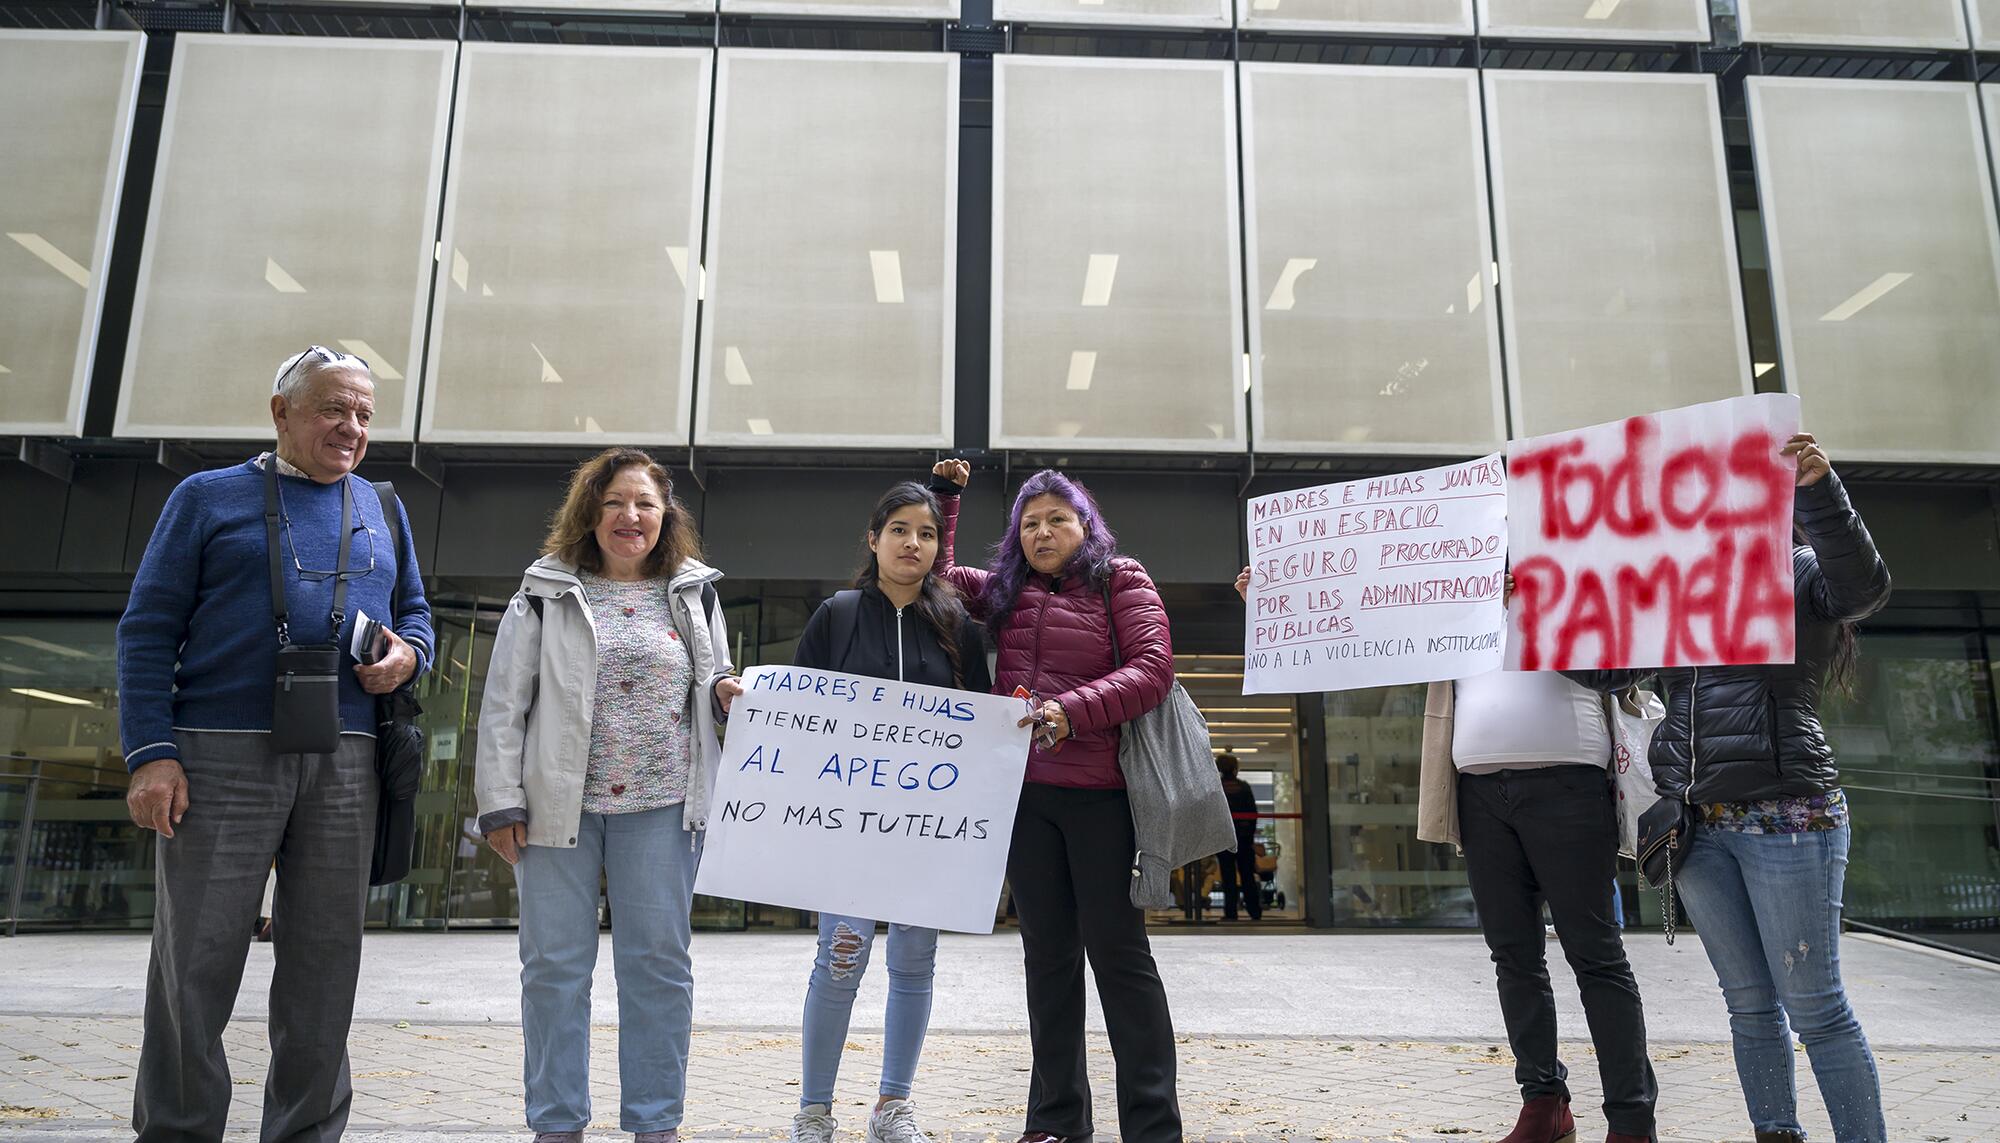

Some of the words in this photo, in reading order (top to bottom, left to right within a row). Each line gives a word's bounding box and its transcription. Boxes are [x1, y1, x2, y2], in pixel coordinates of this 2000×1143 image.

[1254, 489, 1328, 521] MADRES
[1342, 485, 1355, 504] E
[1366, 476, 1425, 500] HIJAS
[1439, 459, 1503, 491] JUNTAS
[1255, 525, 1283, 548] EN
[1299, 518, 1326, 538] UN
[1338, 504, 1439, 536] ESPACIO
[1254, 547, 1357, 589] SEGURO
[1381, 535, 1499, 566] PROCURADO
[1257, 594, 1293, 616] POR
[1308, 589, 1344, 610] LAS
[1274, 652, 1283, 669] A
[1293, 649, 1312, 667] LA
[1325, 637, 1415, 661] VIOLENCIA
[753, 672, 861, 702] MADRES
[872, 687, 886, 701] E
[902, 691, 975, 721] HIJAS
[746, 708, 838, 735] TIENEN
[853, 723, 963, 749] DERECHO
[739, 745, 785, 774] AL
[818, 753, 960, 791] APEGO
[721, 799, 767, 823] NO
[783, 805, 846, 830] MAS
[859, 811, 991, 841] TUTELAS
